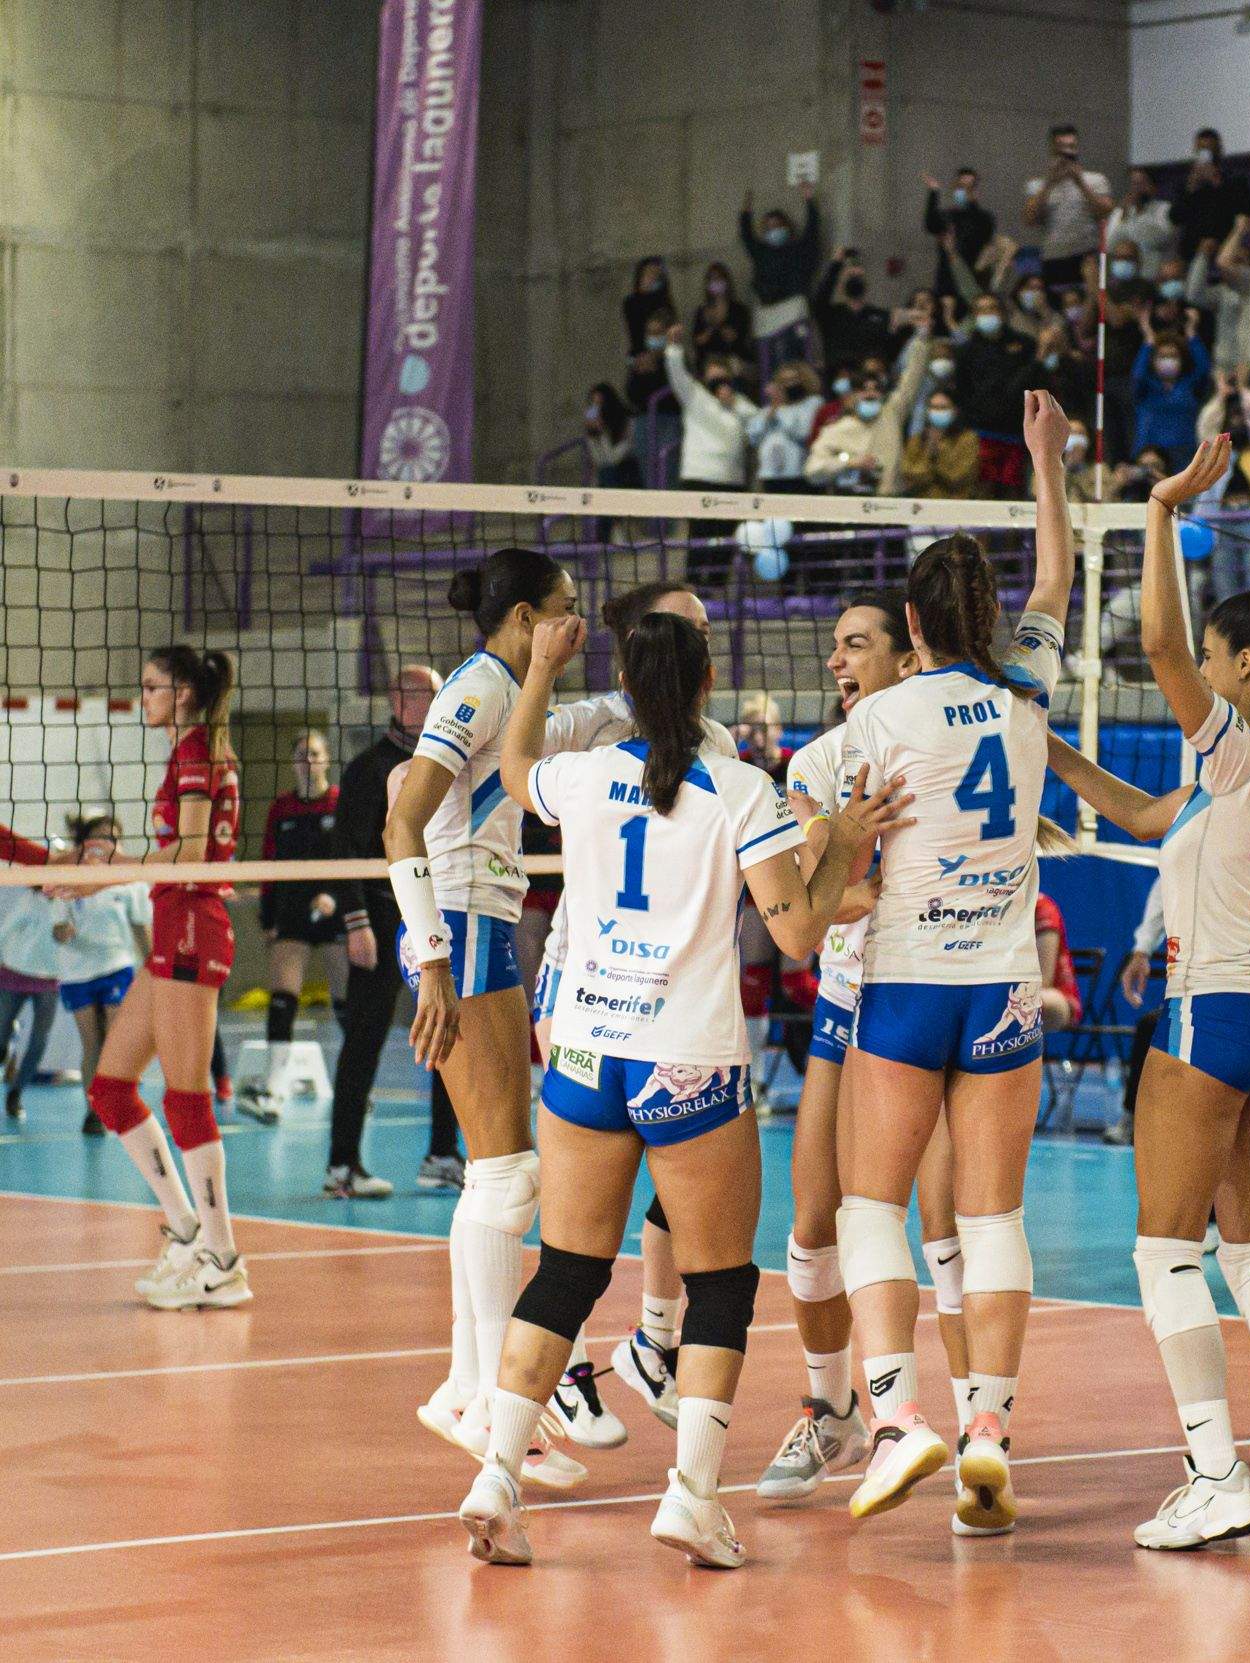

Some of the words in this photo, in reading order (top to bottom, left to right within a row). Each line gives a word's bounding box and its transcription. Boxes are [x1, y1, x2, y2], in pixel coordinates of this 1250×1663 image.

[944, 699, 1001, 727] PROL
[440, 716, 474, 738] Gobierno
[442, 726, 472, 748] Canarias
[952, 732, 1016, 841] 4
[615, 815, 650, 912] 1
[611, 938, 671, 960] DISA
[634, 973, 669, 987] lagunero
[603, 1028, 632, 1041] GEFF
[563, 1046, 594, 1073] VERA
[627, 1088, 731, 1121] PHYSIORELAX
